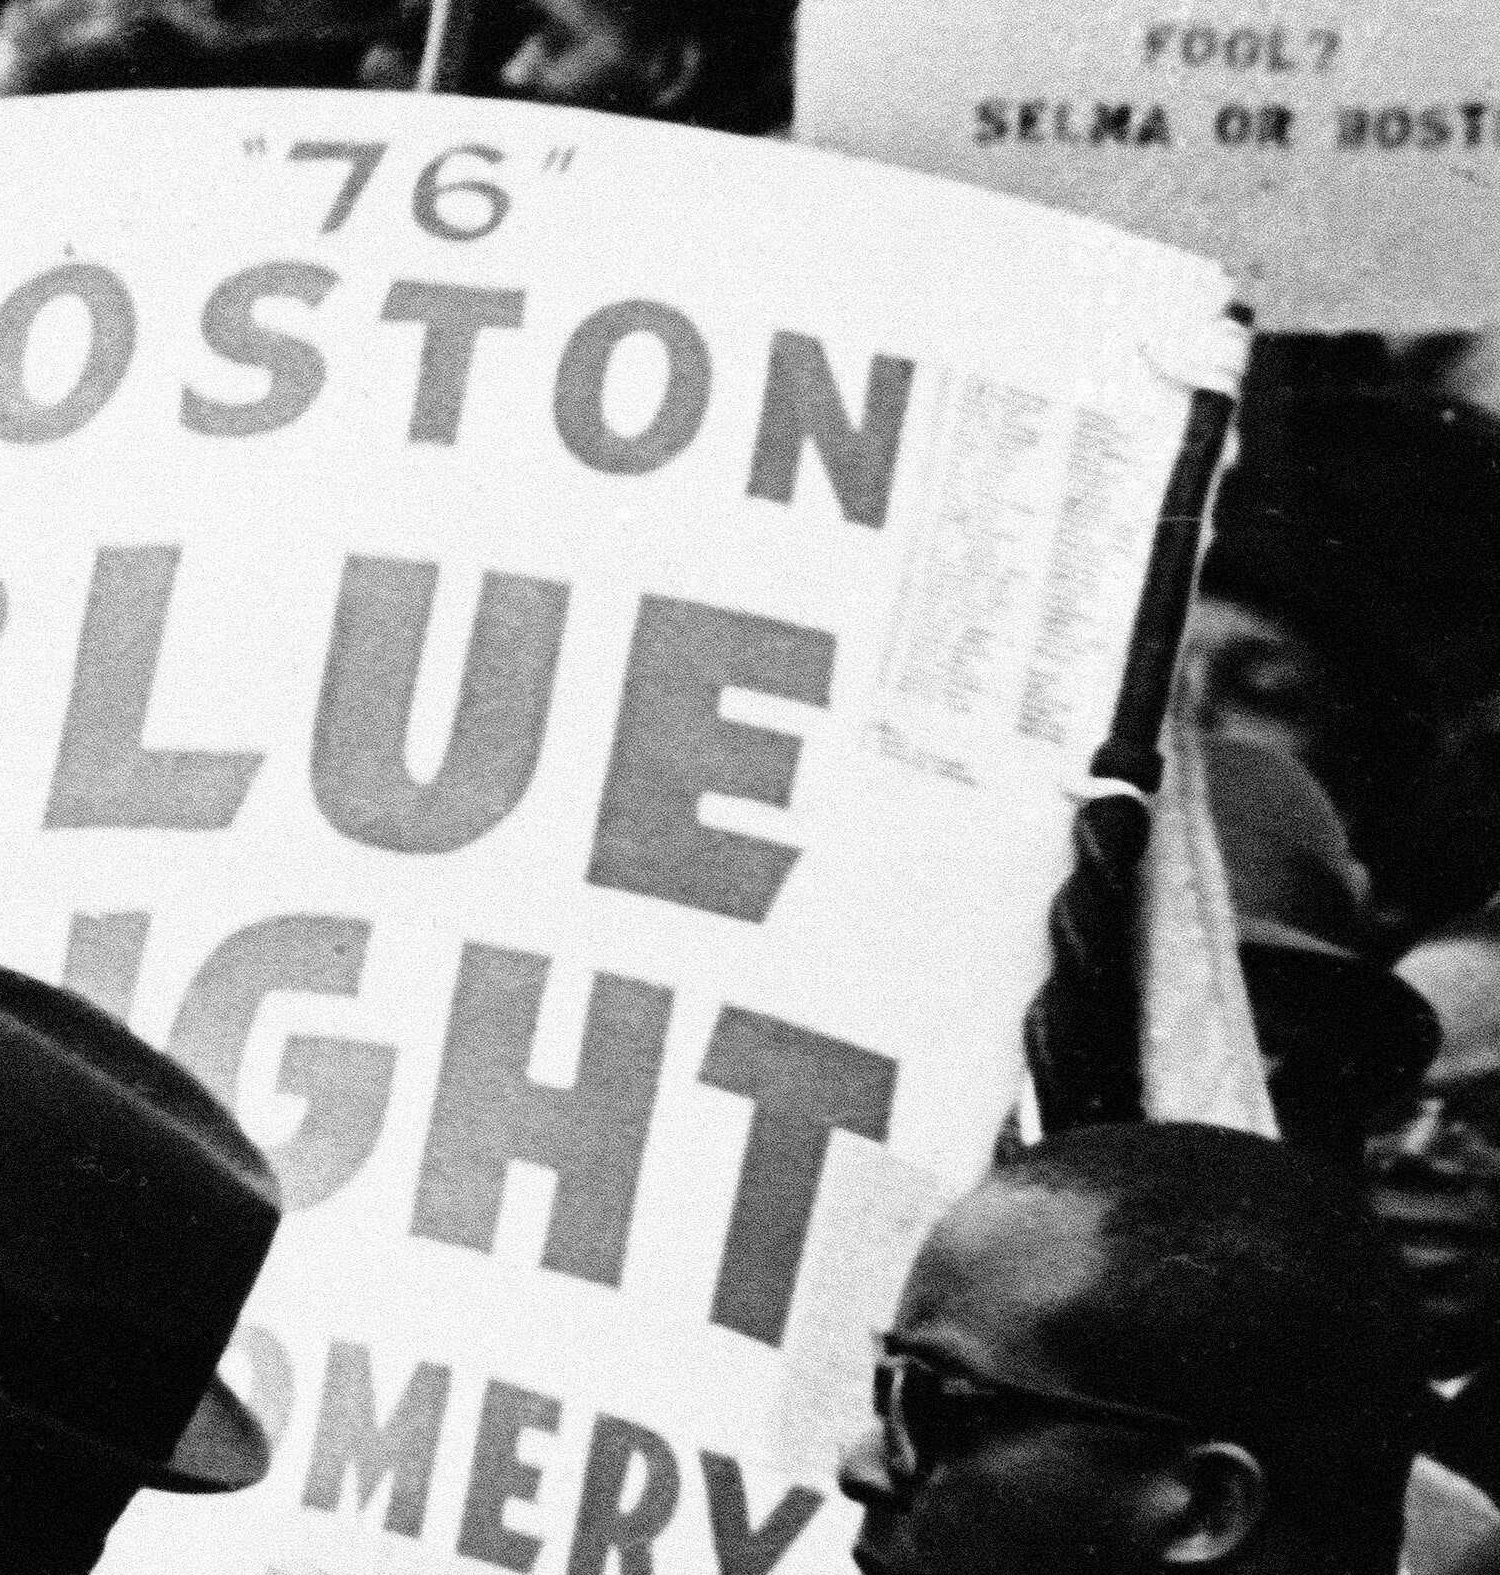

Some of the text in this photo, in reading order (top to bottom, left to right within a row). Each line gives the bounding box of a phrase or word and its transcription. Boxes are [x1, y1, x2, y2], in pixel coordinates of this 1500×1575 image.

[1140, 23, 1341, 74] FOOL?
[974, 97, 1500, 151] SELMA OR BOST
